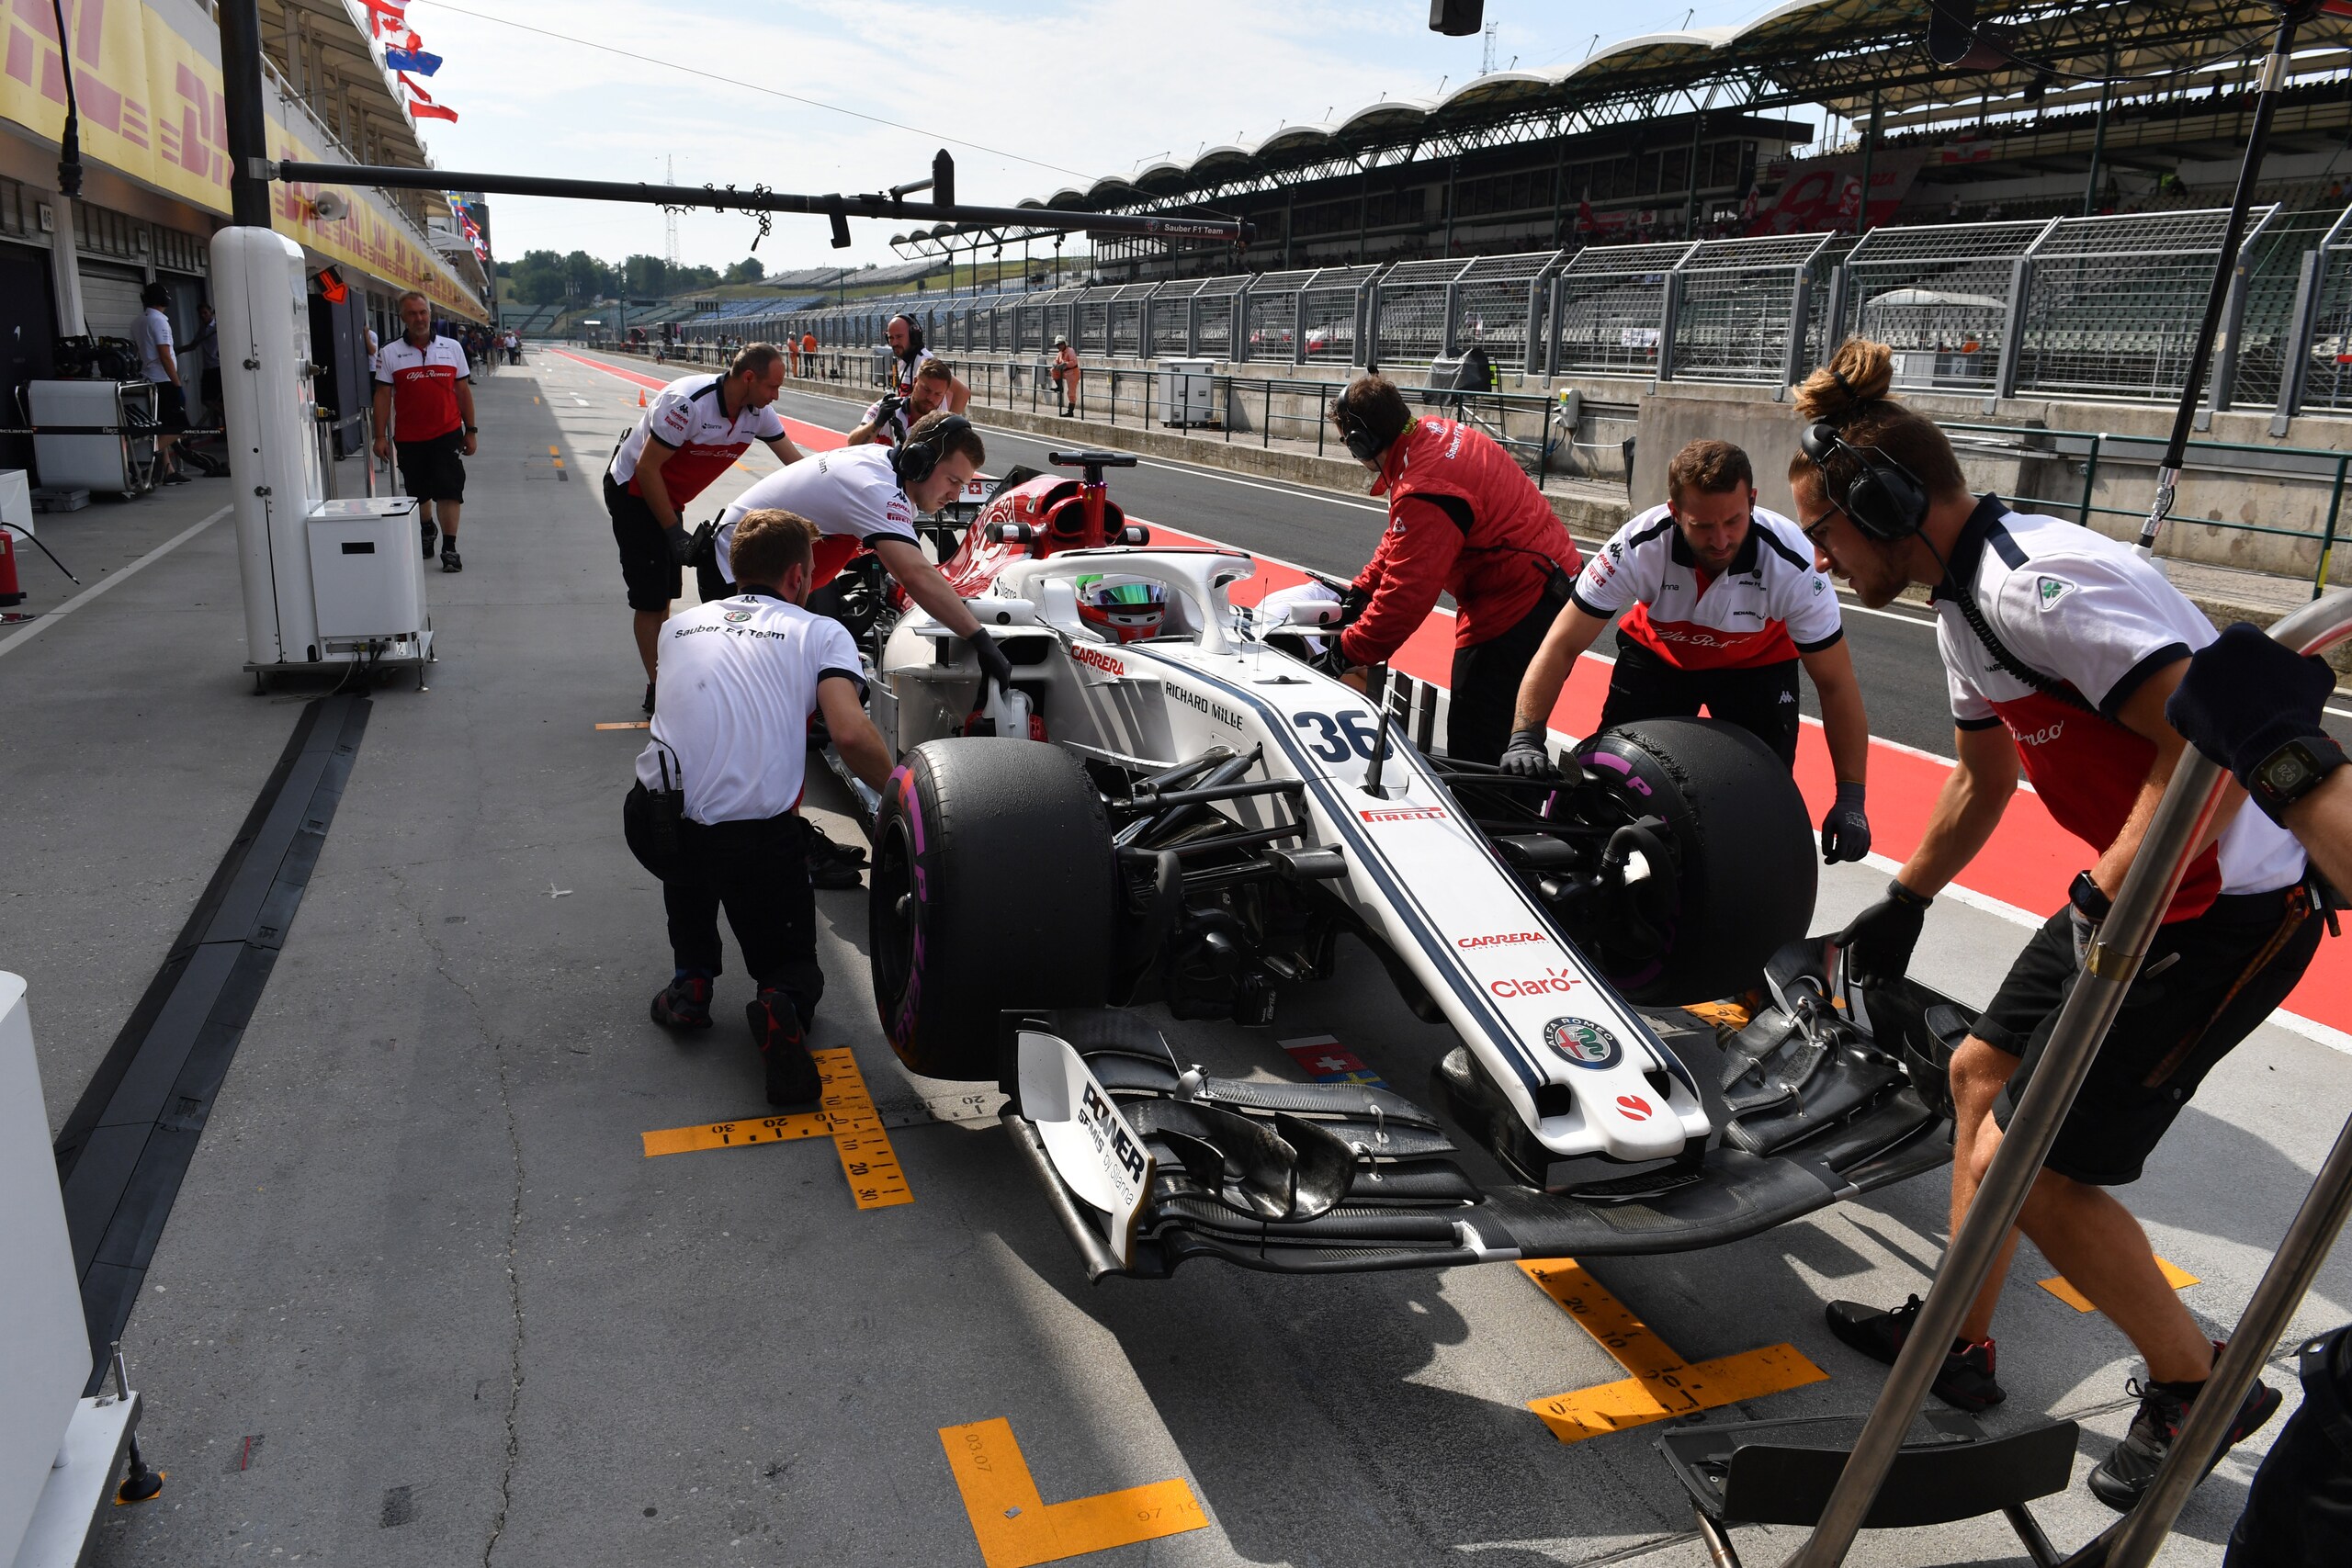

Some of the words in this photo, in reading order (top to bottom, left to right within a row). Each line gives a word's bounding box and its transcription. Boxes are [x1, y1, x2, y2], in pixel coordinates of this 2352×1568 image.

[1164, 223, 1191, 232] Sauber
[1204, 227, 1224, 235] Team
[424, 369, 451, 378] Romeo
[674, 625, 720, 639] Sauber
[748, 628, 786, 640] Team
[1070, 645, 1124, 676] CARRERA
[1165, 681, 1208, 714] RICHARD
[1212, 704, 1243, 731] MILLE
[1293, 710, 1395, 763] 36
[1360, 807, 1447, 823] PIRELLI
[1458, 931, 1547, 948] CARRERA
[1490, 970, 1576, 998] Claro
[1545, 1022, 1560, 1046] ALFA
[1561, 1018, 1613, 1041] ROMEO
[1083, 1080, 1145, 1184] POWER
[849, 1162, 869, 1176] 20
[1110, 1163, 1135, 1206] Silanna
[858, 1188, 879, 1201] 30
[1137, 1507, 1162, 1522] 97
